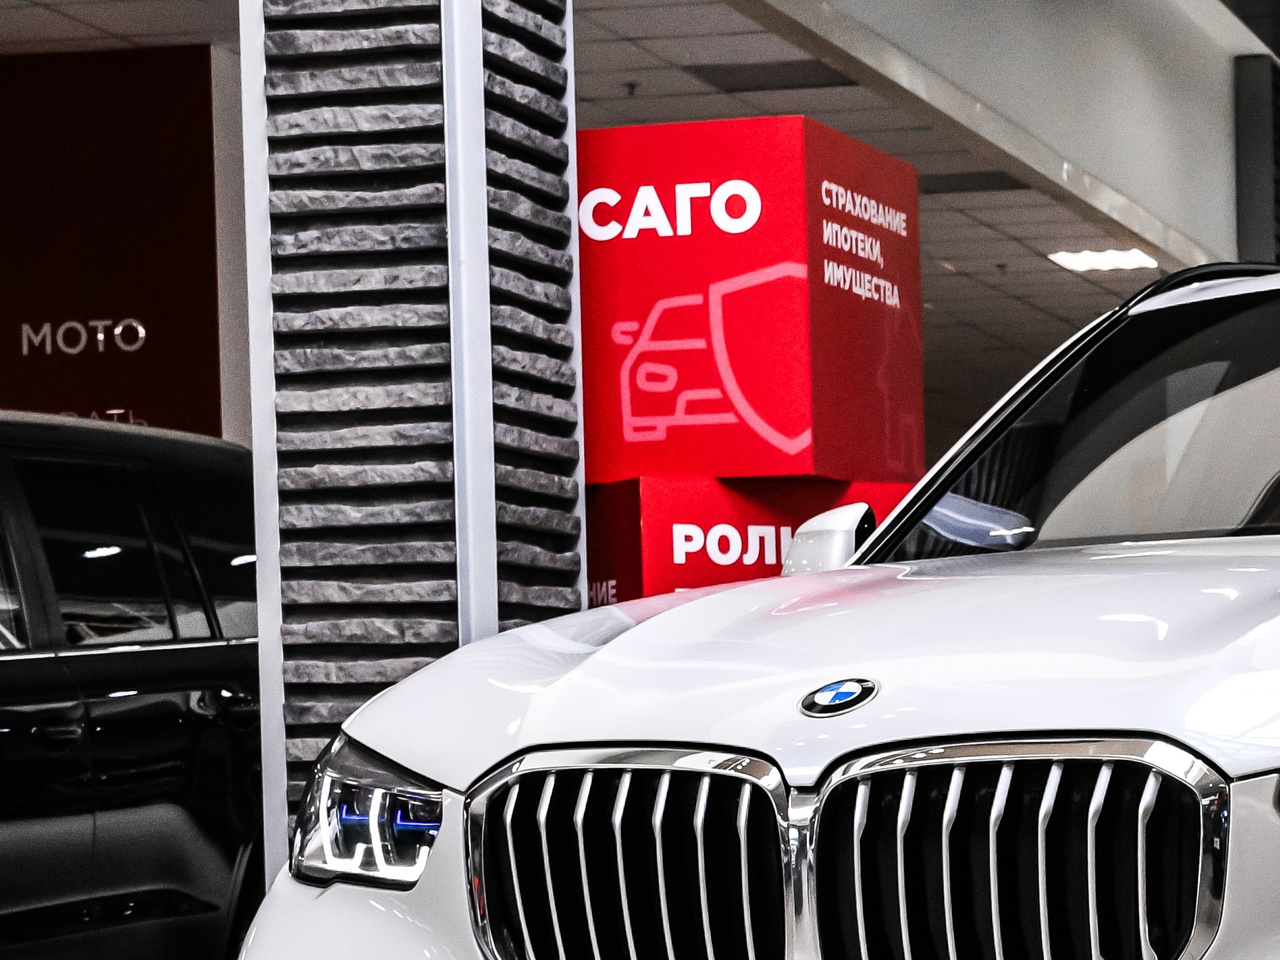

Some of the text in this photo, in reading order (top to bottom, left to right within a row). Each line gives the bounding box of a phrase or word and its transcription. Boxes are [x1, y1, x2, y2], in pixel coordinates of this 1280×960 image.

[579, 179, 762, 241] САГО
[821, 179, 907, 237] СТРАХОВАНИЕ
[822, 218, 884, 269] ИПОТЕКИ,
[823, 259, 900, 309] ИМУЩЕСТВА
[21, 318, 147, 356] МОТО
